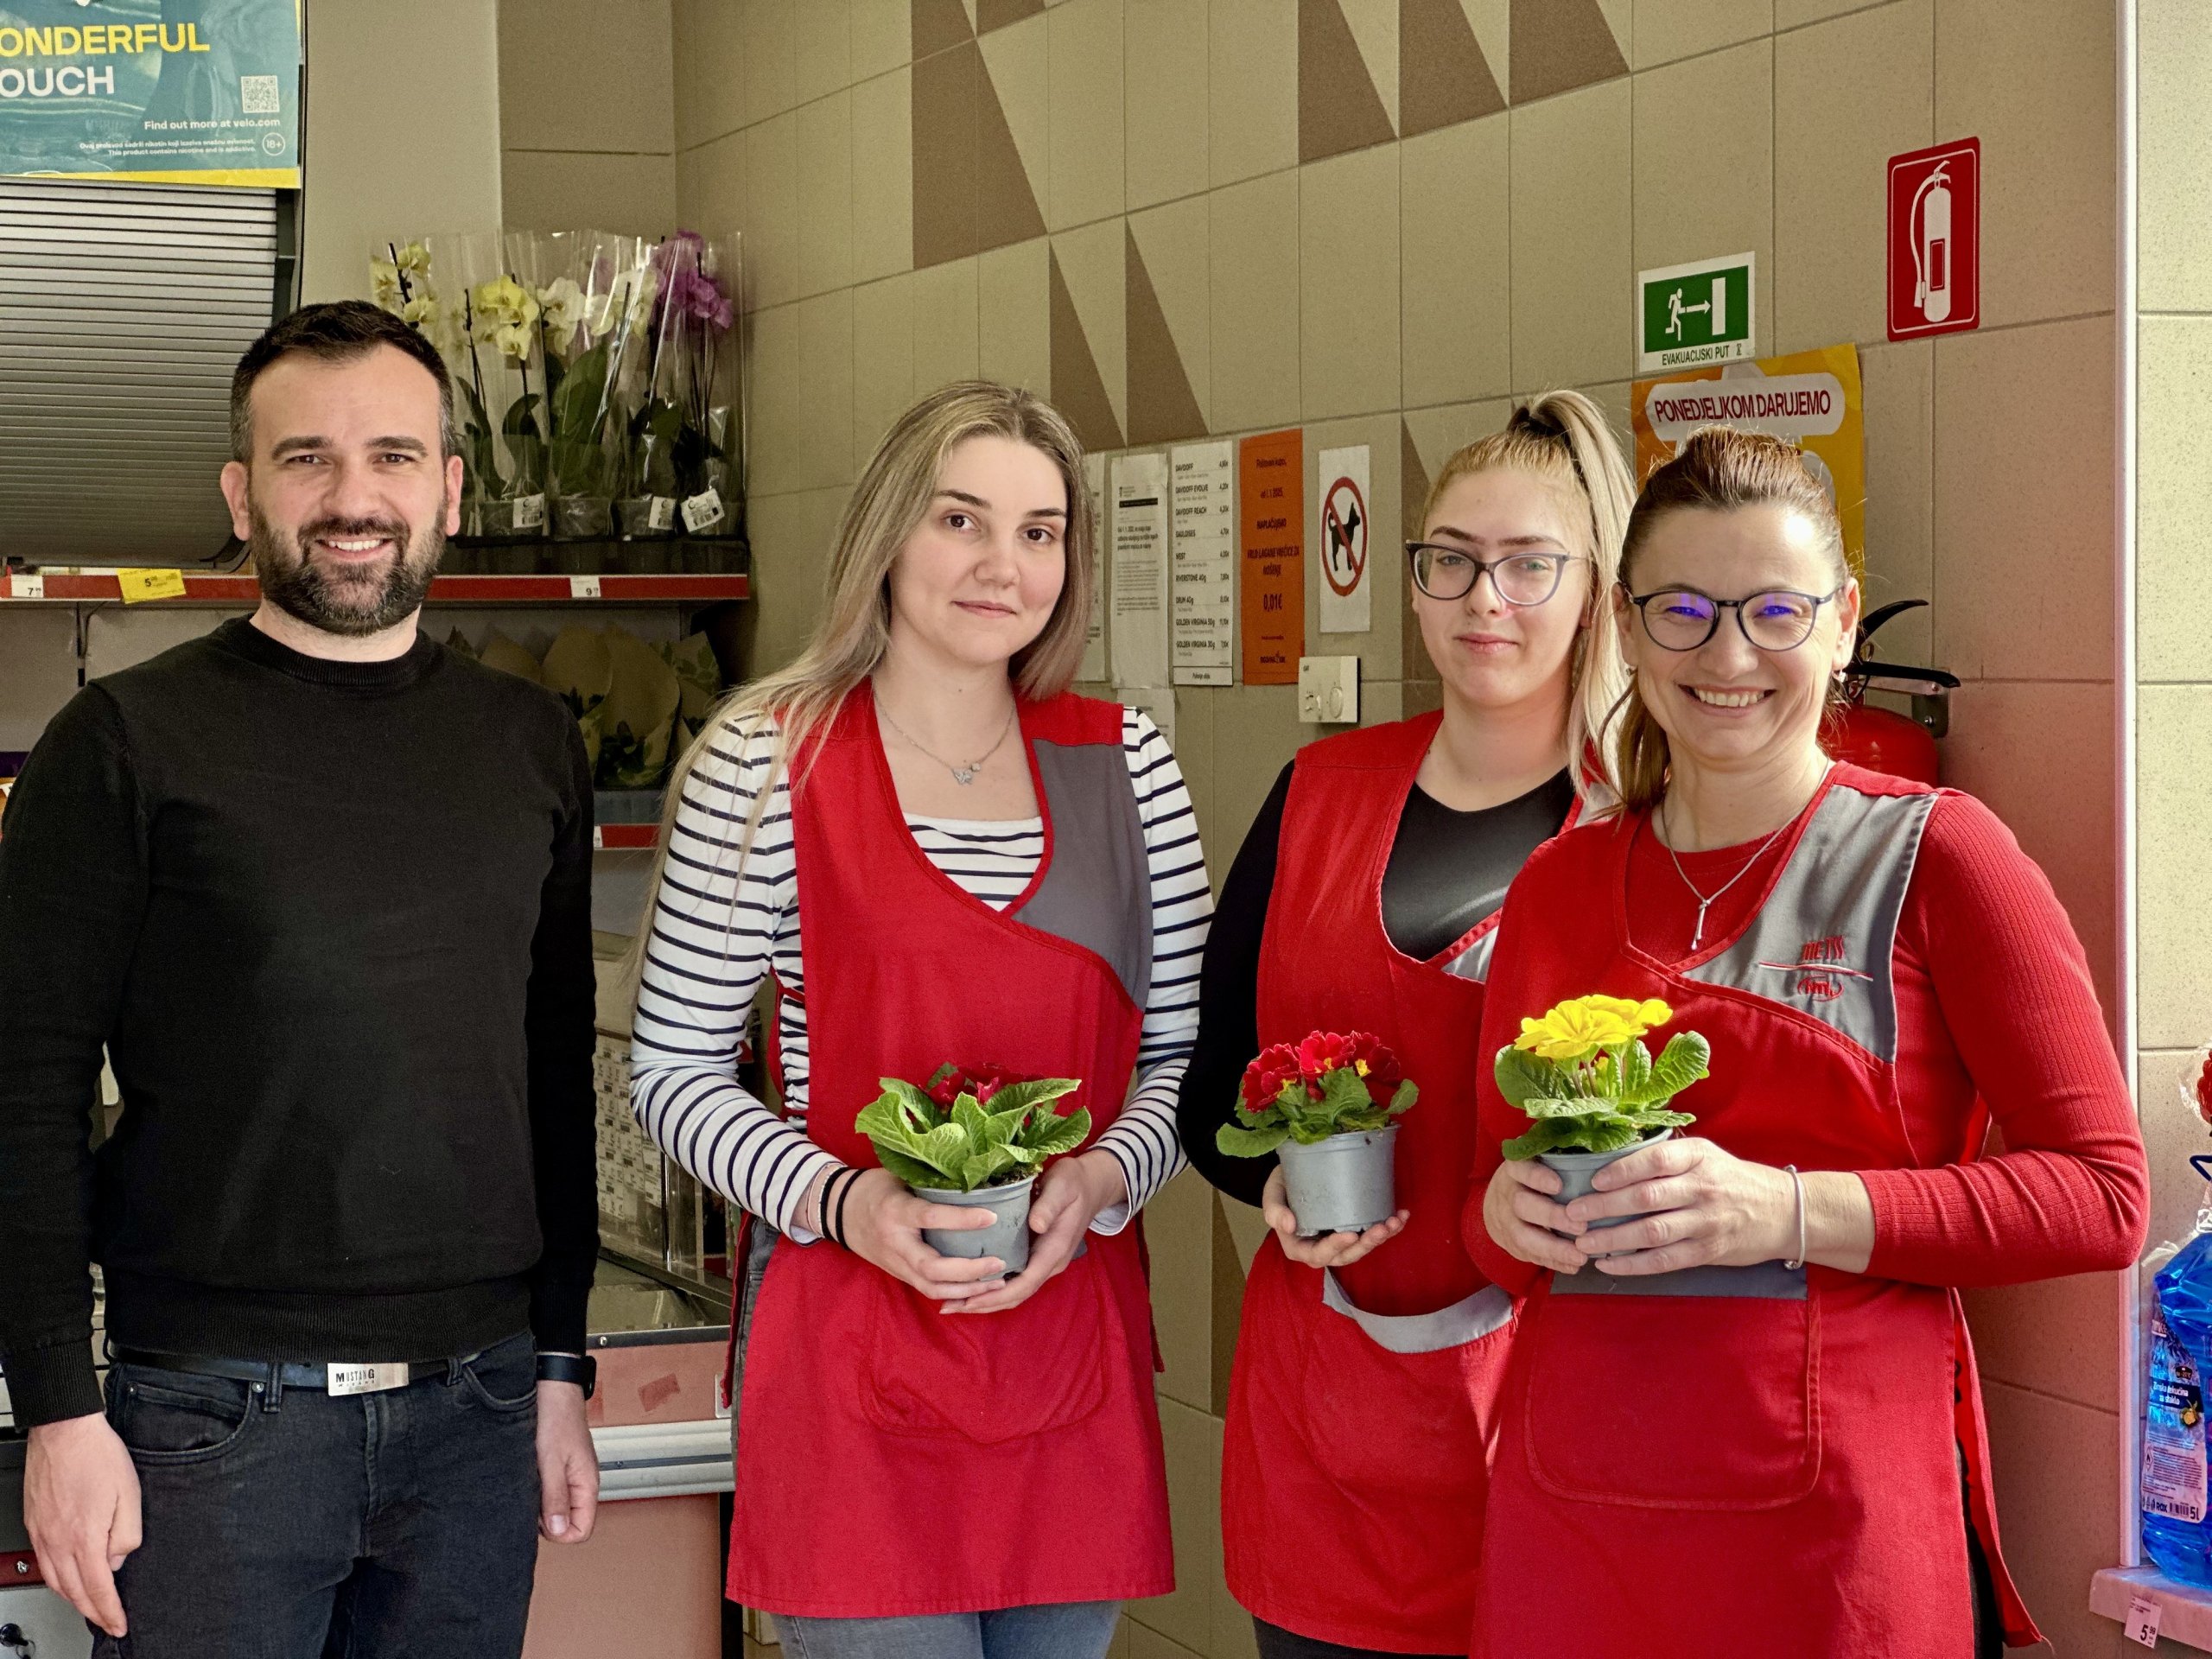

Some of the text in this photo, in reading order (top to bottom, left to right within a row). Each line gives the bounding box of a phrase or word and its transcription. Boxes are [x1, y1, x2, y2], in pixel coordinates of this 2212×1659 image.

[144, 118, 281, 130] Find out more at velo.com
[266, 139, 282, 149] 18+
[1662, 345, 1729, 365] EVAKUACIJSKI PUT
[1655, 390, 1831, 423] PONEDJELJKOM DARUJEMO
[144, 578, 152, 588] 5
[28, 587, 34, 596] 7
[585, 588, 592, 596] 9
[1263, 593, 1282, 613] 0,01€
[1176, 640, 1191, 649] GOLDEN
[335, 1369, 375, 1382] MUSTANG
[2156, 1502, 2168, 1513] ROX
[2139, 1624, 2149, 1641] 5
